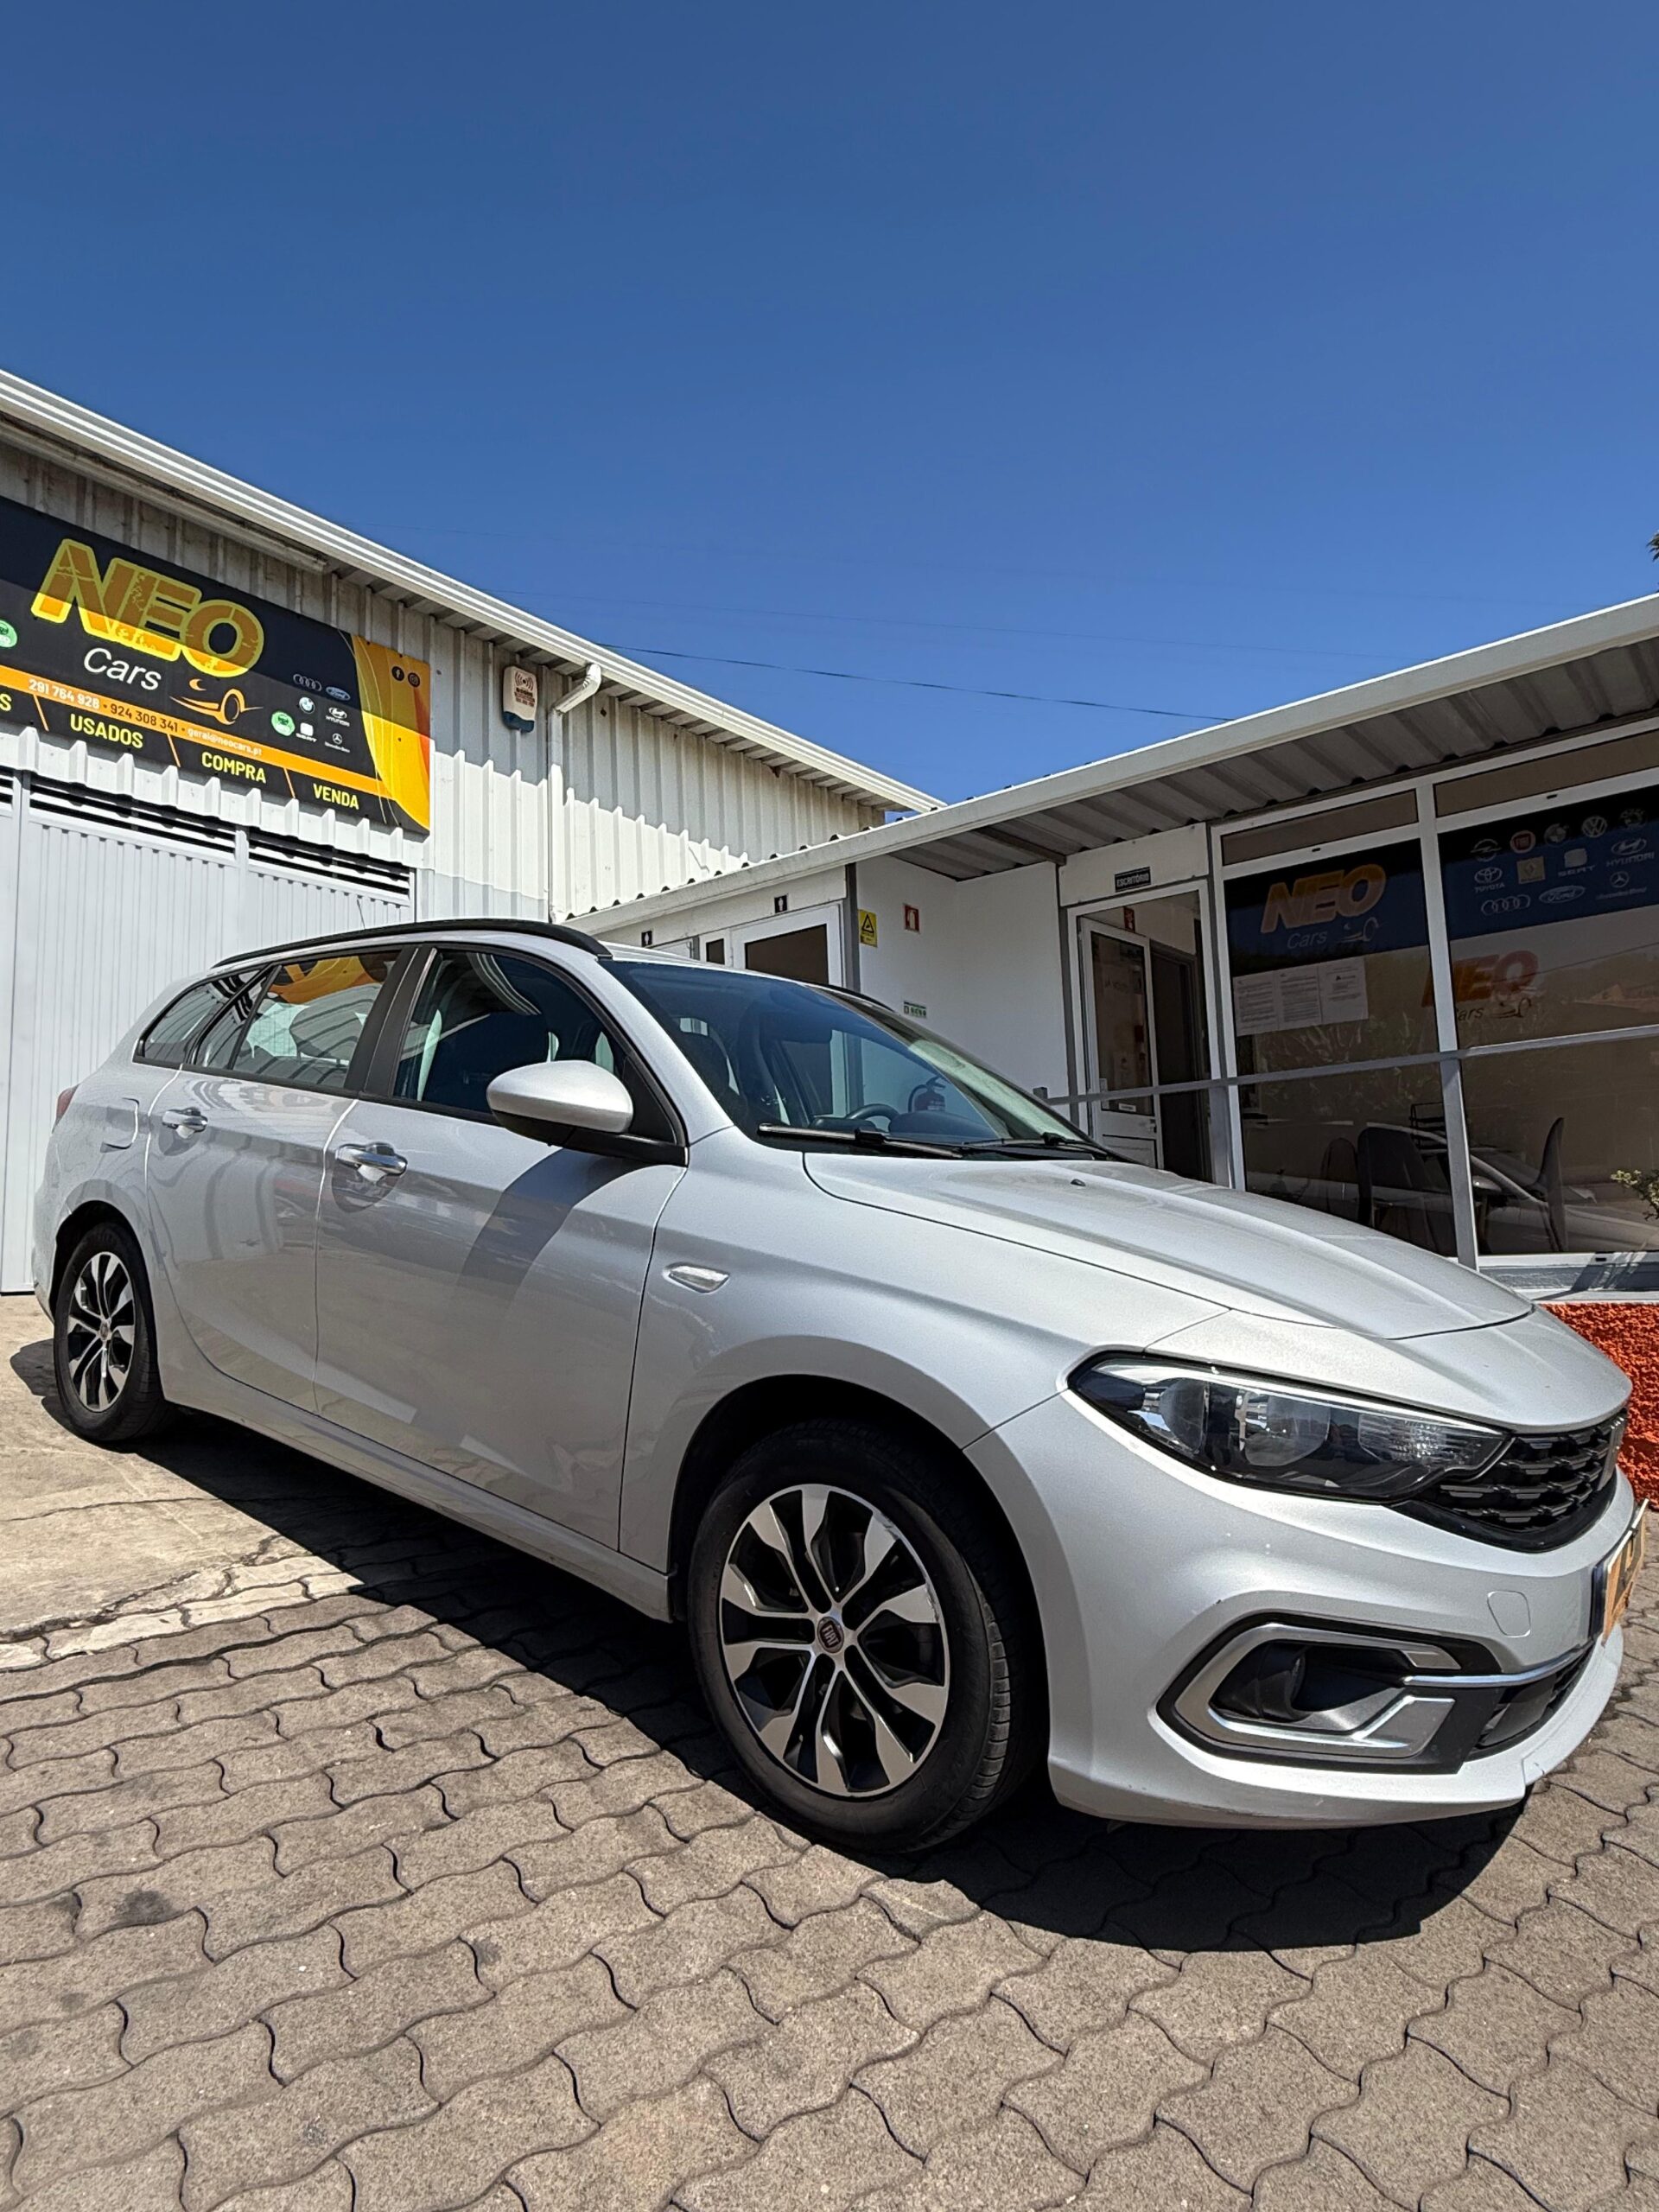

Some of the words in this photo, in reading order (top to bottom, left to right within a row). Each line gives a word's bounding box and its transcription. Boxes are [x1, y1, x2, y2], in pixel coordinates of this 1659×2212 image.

[30, 538, 264, 677] NEO
[84, 648, 162, 690] Cars
[29, 678, 49, 696] 291
[52, 683, 75, 702] 764
[77, 693, 100, 709] 928
[110, 703, 132, 719] 924
[135, 710, 157, 726] 308
[159, 718, 178, 733] 341
[70, 714, 143, 749] USADOS
[201, 752, 266, 784] COMPRA
[313, 783, 359, 810] VENDA
[1260, 864, 1387, 933] NEO
[1474, 881, 1505, 893] TOYOTA
[1287, 930, 1328, 950] Cars
[1456, 1007, 1485, 1022] ars
